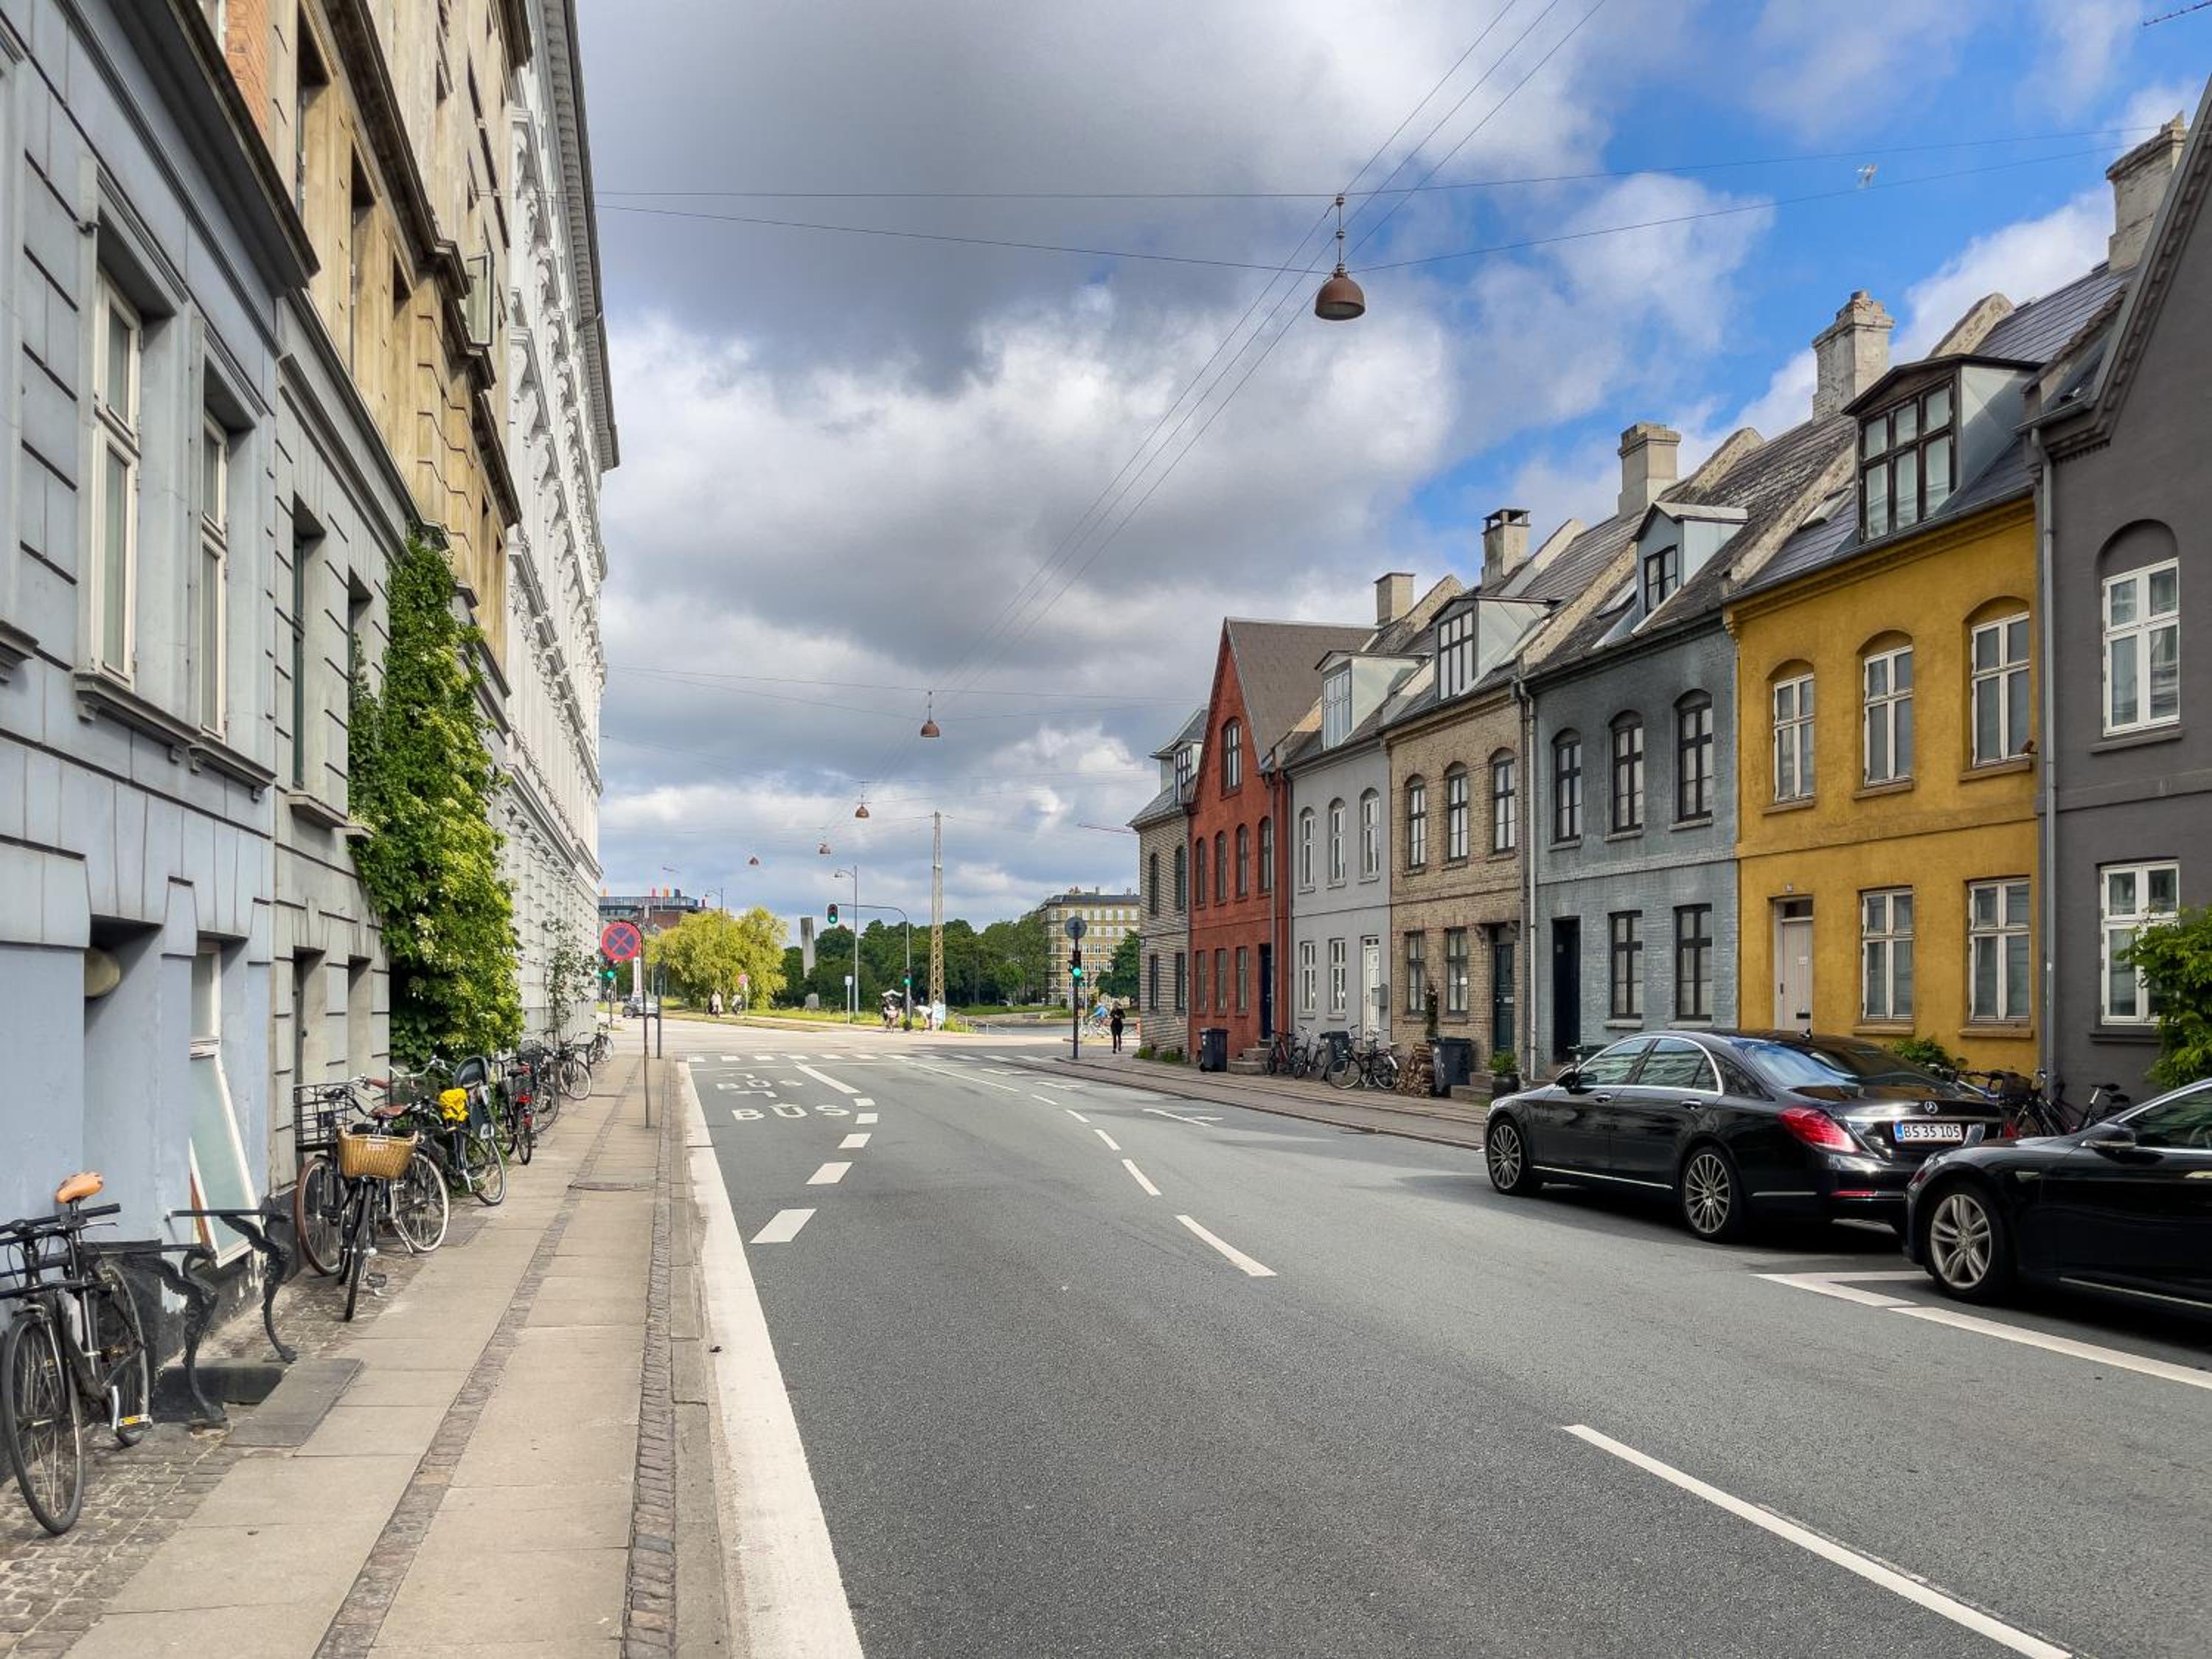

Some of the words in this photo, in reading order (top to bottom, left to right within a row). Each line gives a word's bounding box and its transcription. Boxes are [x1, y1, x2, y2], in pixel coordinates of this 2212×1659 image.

[731, 1104, 850, 1120] BUS
[1904, 1126, 1919, 1138] BS
[1922, 1126, 1937, 1138] 35
[1940, 1126, 1960, 1138] 105
